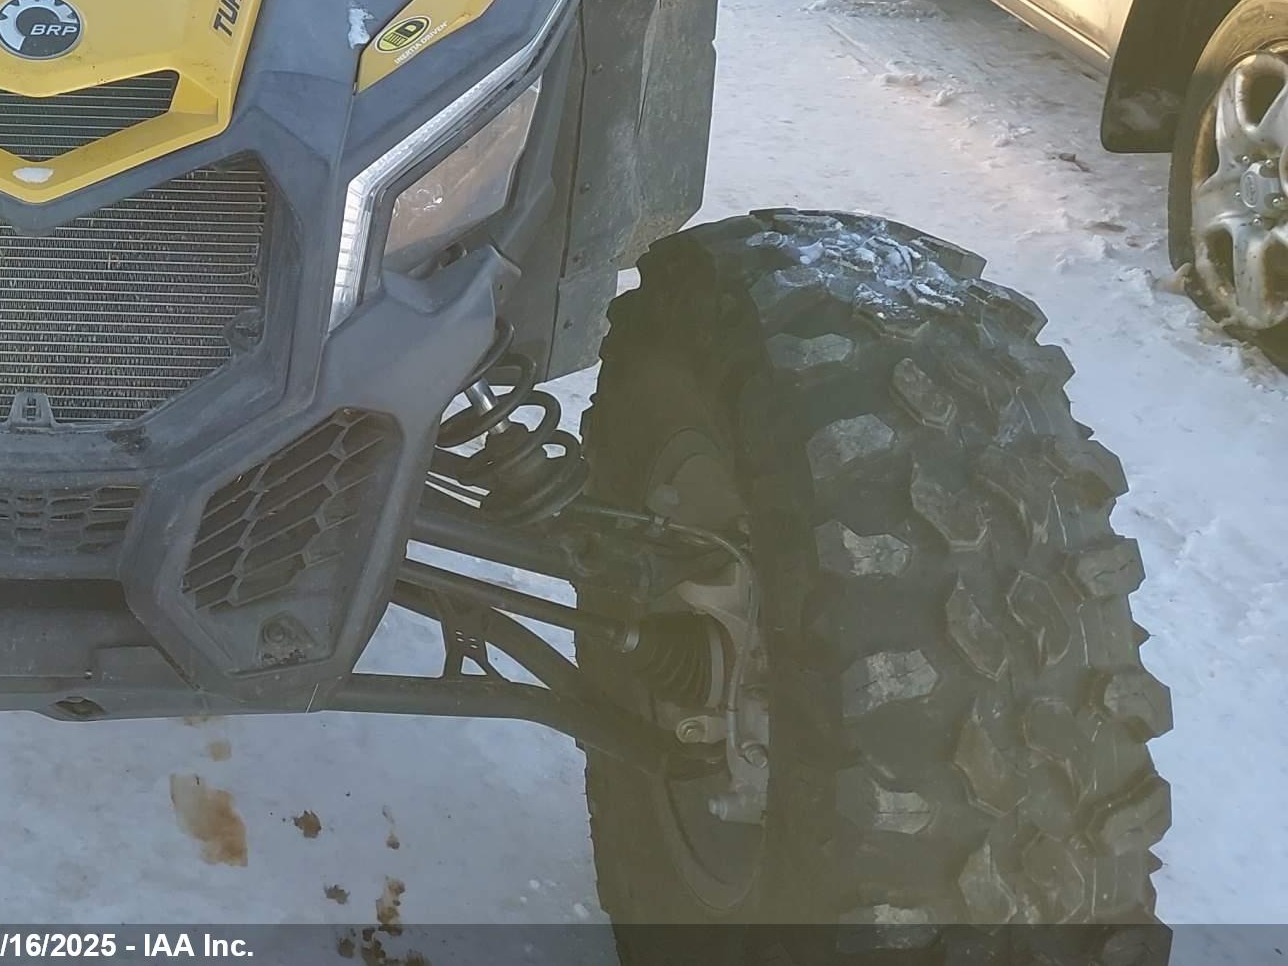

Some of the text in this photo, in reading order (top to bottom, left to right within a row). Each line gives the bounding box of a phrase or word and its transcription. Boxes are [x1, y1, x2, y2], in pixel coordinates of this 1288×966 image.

[30, 24, 78, 36] BRP
[393, 21, 448, 64] INERTIA DRIVEN
